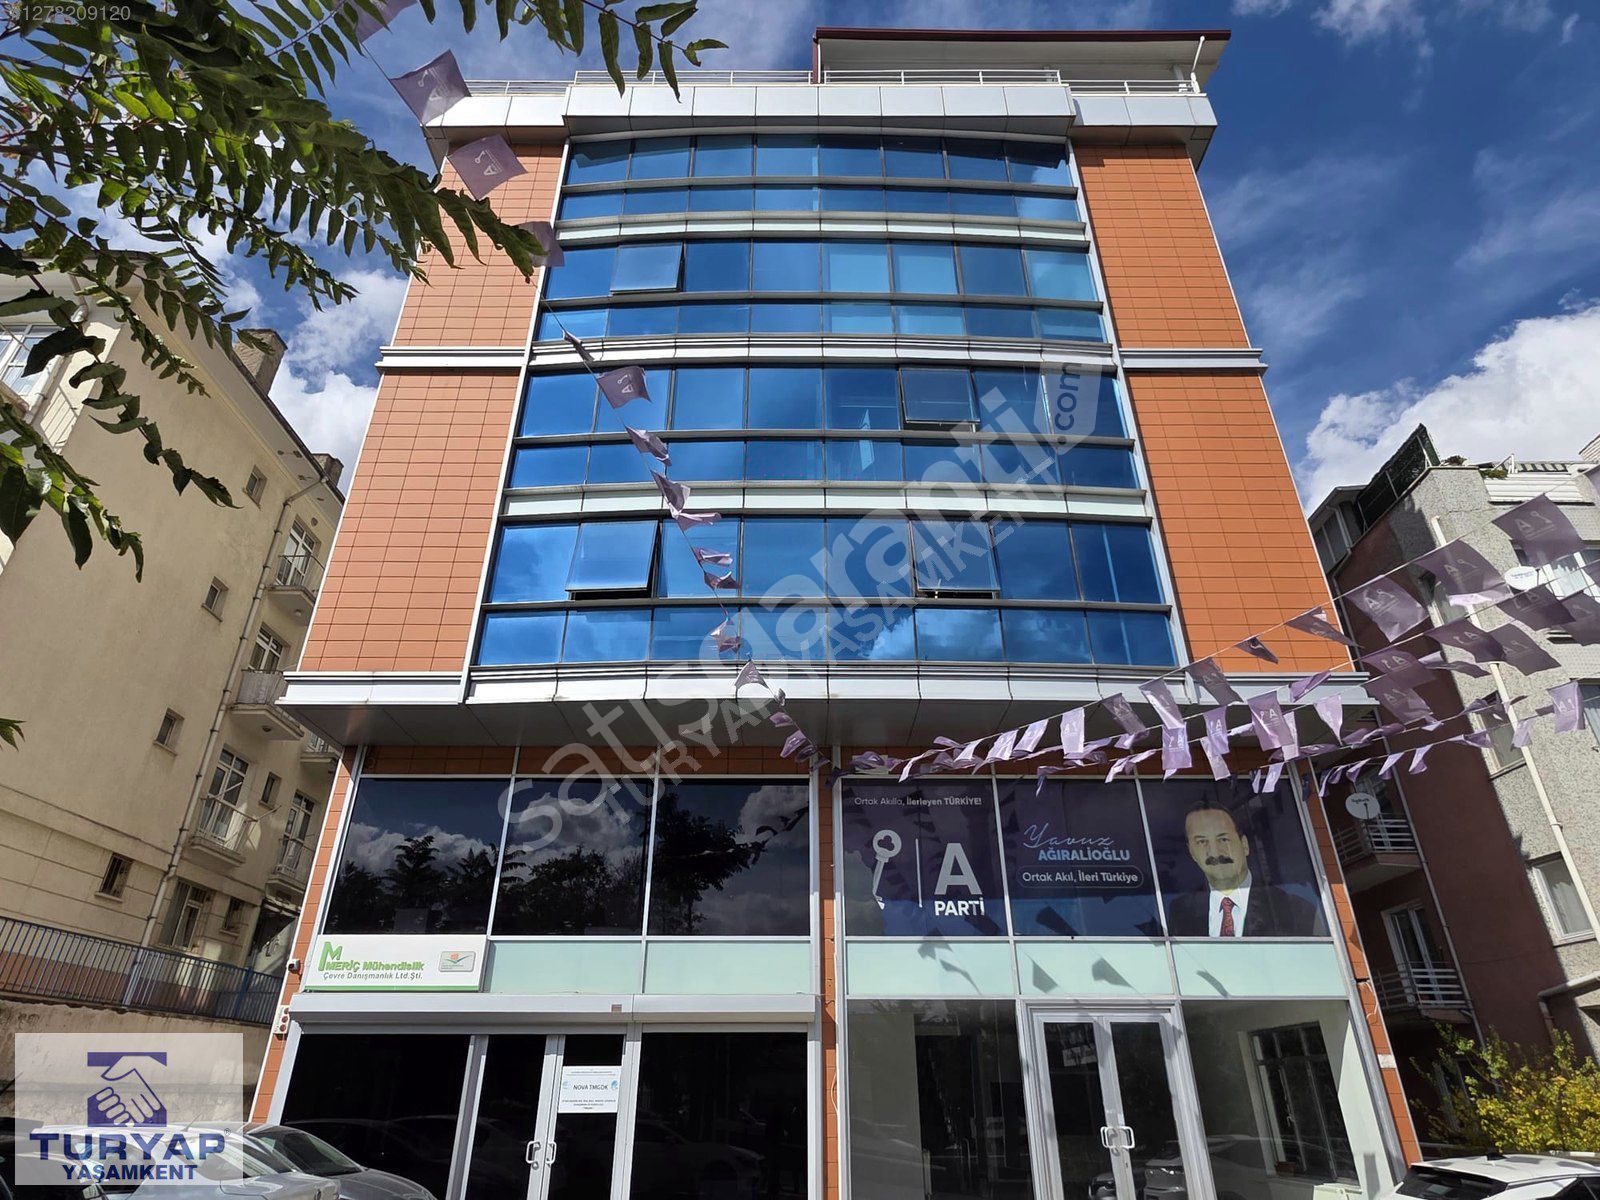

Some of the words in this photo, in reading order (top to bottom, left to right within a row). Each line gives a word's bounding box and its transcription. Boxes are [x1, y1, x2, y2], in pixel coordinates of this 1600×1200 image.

[854, 797, 878, 806] Ortak
[943, 795, 982, 805] TÜRKİYE!
[1023, 822, 1114, 849] Yavuz
[1038, 846, 1131, 861] AĞIRALİOĞLU
[934, 842, 983, 895] A
[1022, 872, 1053, 882] Ortak
[1055, 871, 1077, 882] Akıl,
[1078, 869, 1099, 882] İleri
[1101, 871, 1138, 883] Türkiye
[934, 897, 985, 916] PARTİ
[362, 961, 425, 971] Mühendislik
[323, 971, 345, 980] Çevre
[347, 971, 393, 980] Danışmanlık
[395, 971, 423, 980] Ltd.Şti.
